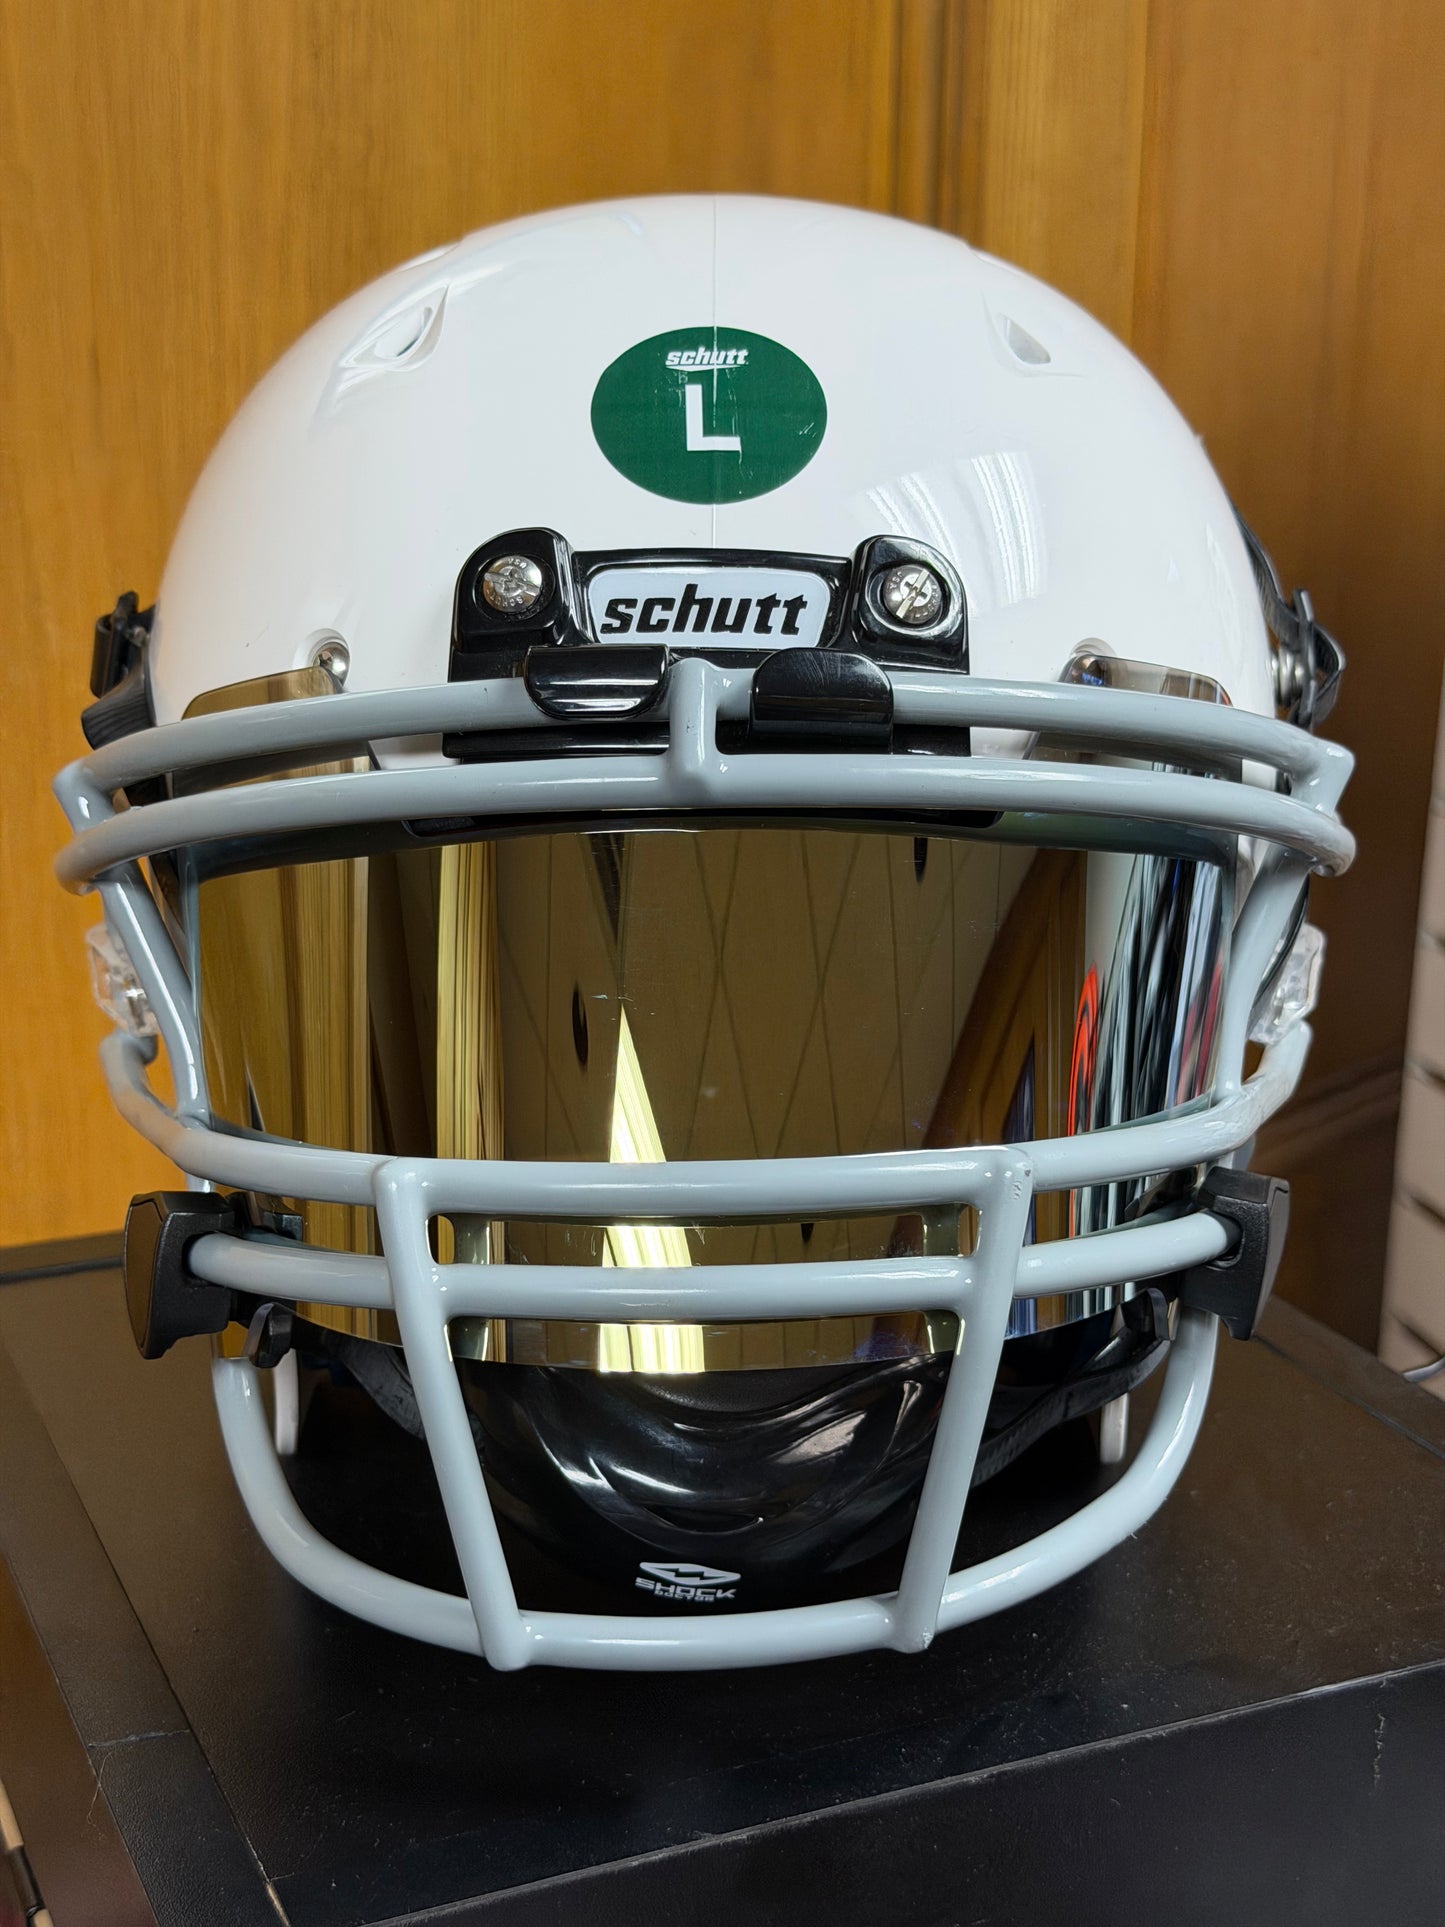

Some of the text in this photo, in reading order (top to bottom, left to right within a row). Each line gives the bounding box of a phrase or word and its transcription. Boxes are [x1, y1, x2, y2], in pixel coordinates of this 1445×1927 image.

[665, 346, 748, 366] schutt
[685, 384, 741, 451] L
[600, 584, 807, 635] schutt
[635, 1577, 736, 1599] SHOCK
